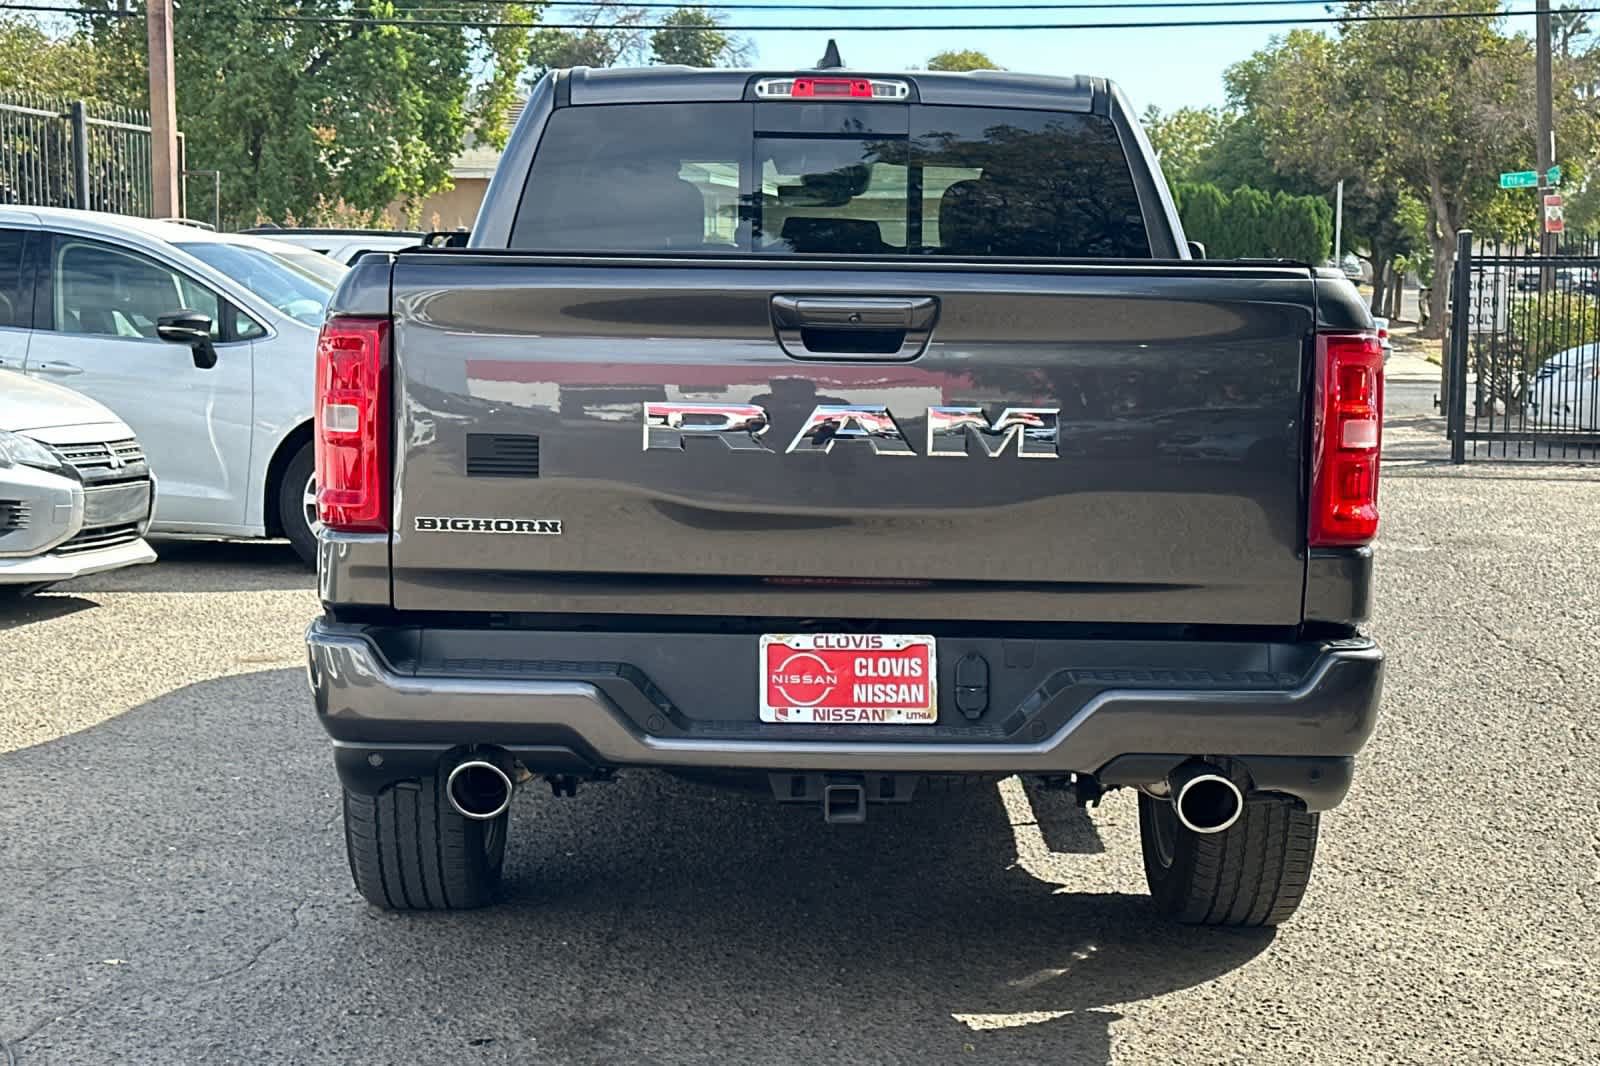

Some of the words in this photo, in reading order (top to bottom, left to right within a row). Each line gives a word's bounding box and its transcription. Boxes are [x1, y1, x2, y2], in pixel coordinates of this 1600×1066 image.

[643, 402, 1061, 458] RAM
[415, 517, 562, 535] BIGHORN
[813, 635, 883, 649] CLOVIS
[854, 658, 922, 677] CLOVIS
[772, 675, 837, 684] NISSAN
[853, 684, 924, 703] NISSAN
[813, 709, 885, 721] NISSAN
[906, 711, 931, 720] LITHIA
